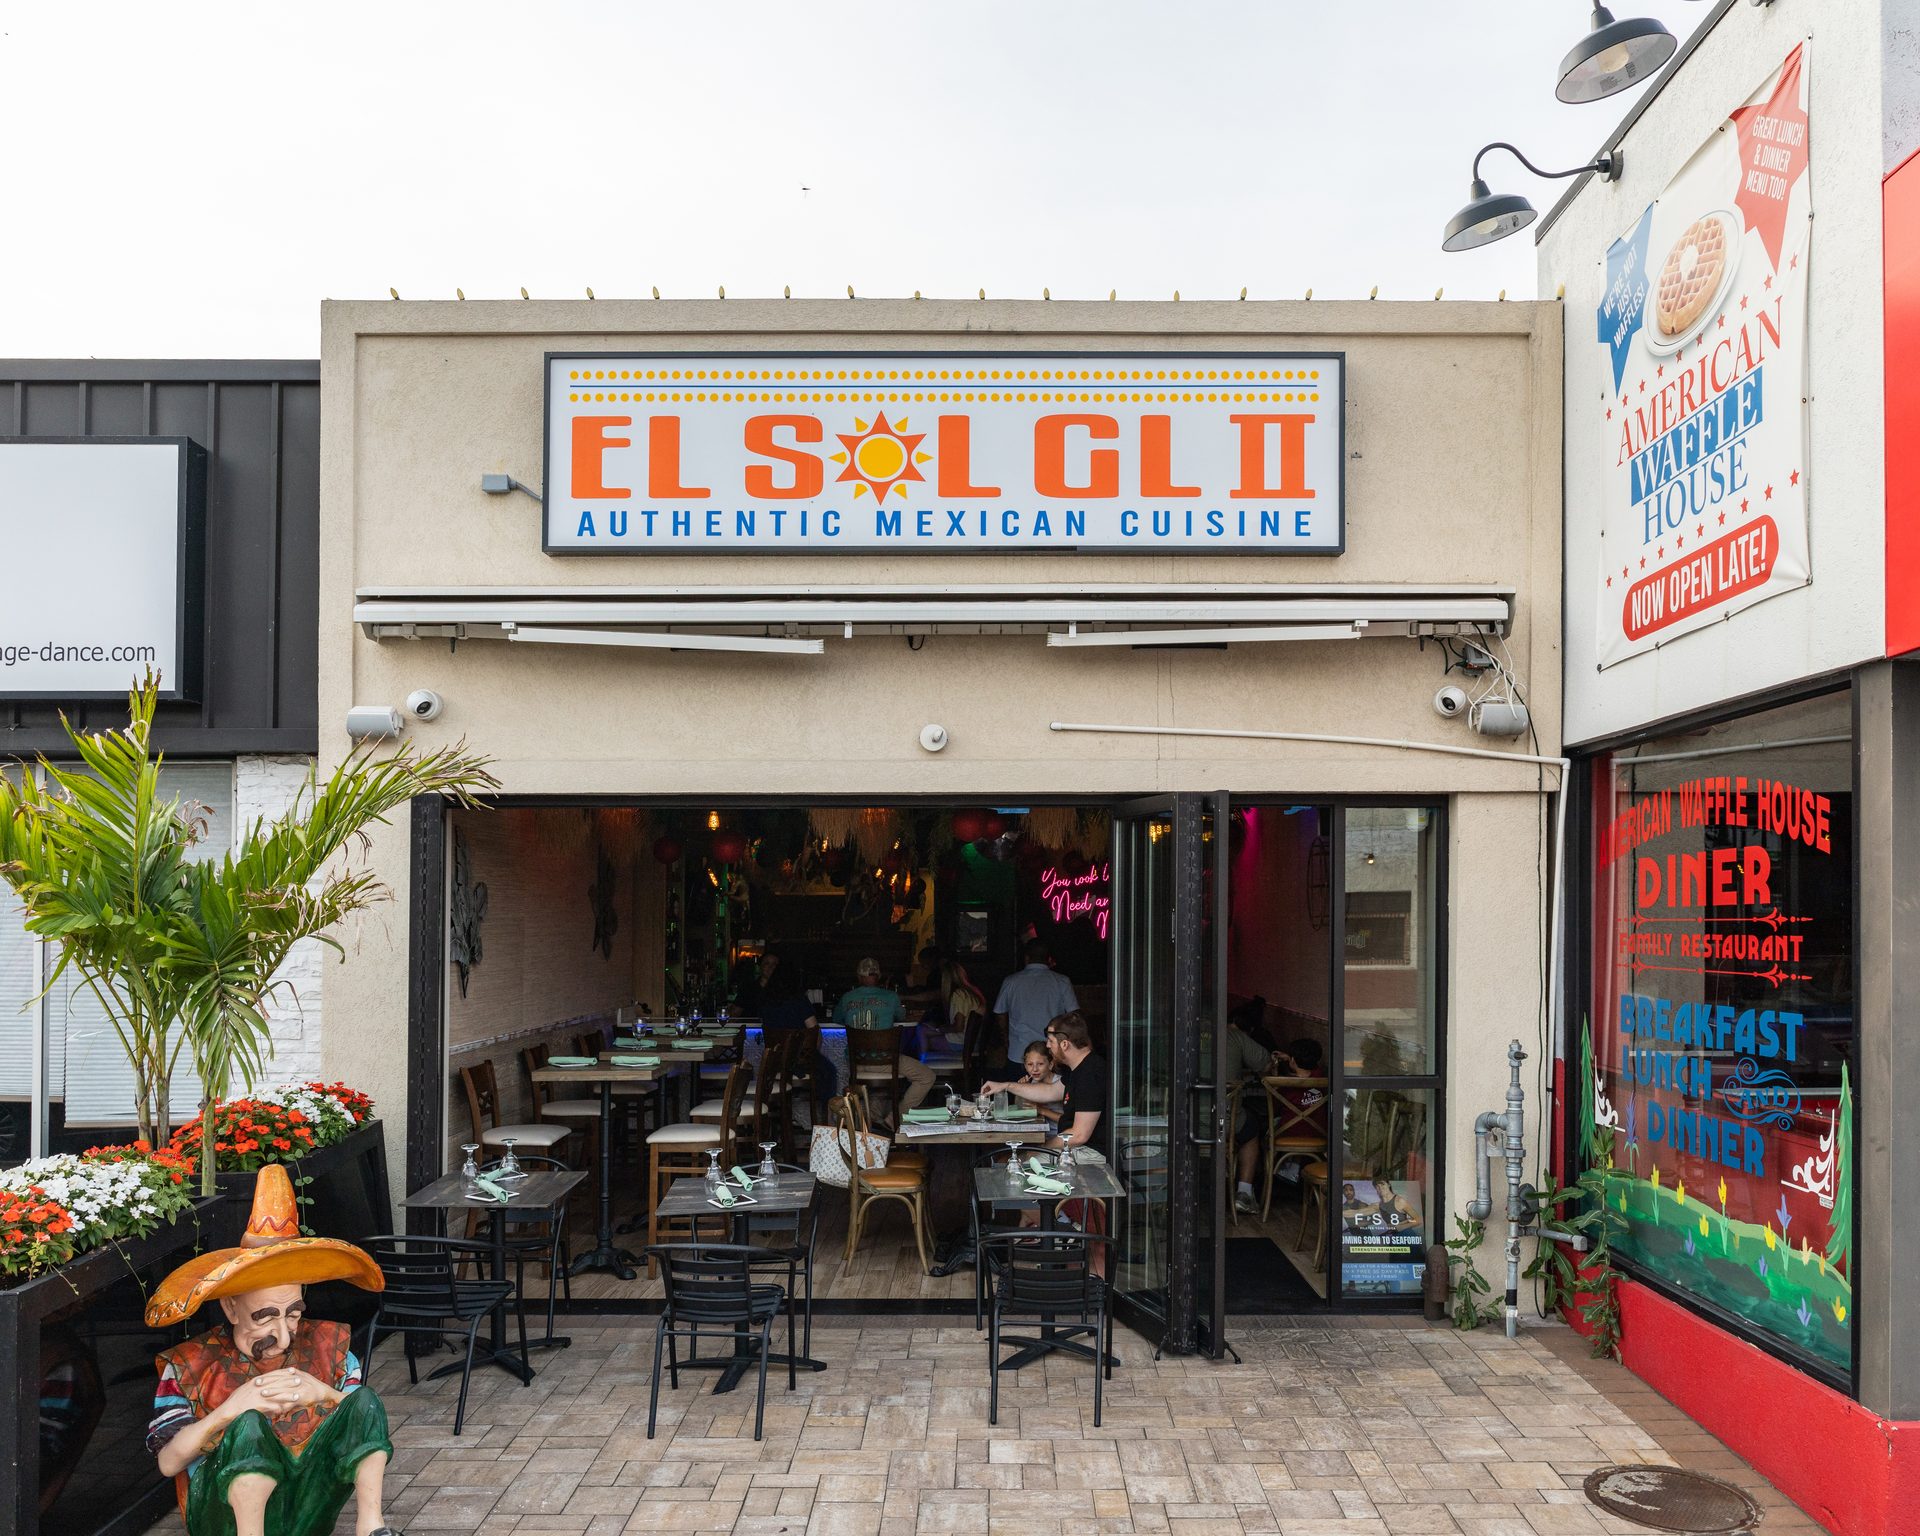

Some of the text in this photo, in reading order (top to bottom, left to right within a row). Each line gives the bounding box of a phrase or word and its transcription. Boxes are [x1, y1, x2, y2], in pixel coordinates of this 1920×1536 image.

[1752, 115, 1805, 147] GREAT LUNCH
[1753, 143, 1791, 173] & DINNER
[1745, 169, 1787, 201] MENU TOO!
[1603, 242, 1638, 320] WE'RE NOT
[1616, 280, 1633, 320] JUST
[1613, 282, 1645, 350] WAFFLES!
[1616, 295, 1784, 468] AMERICAN
[572, 415, 710, 498] EL
[1230, 414, 1315, 498] II
[1633, 373, 1761, 503] WAFFLE
[1643, 437, 1749, 546] HOUSE
[577, 510, 1312, 537] AUTHENTIC MEXICAN CUISINE
[1631, 524, 1768, 632] NOW OPEN LATE!
[1679, 776, 1748, 828] WAFFLE
[1757, 778, 1831, 855] HOUSE
[1041, 866, 1071, 899] You
[1051, 889, 1092, 922] Need
[1637, 846, 1771, 908] DINER
[1619, 932, 1803, 962] FAMILY RESTAURANT
[1620, 993, 1803, 1062] BREAKFAST
[1622, 1045, 1711, 1100] LUNCH
[1734, 1085, 1790, 1110] AND
[1648, 1100, 1764, 1177] DINNER
[1363, 1235, 1381, 1244] SOON
[1382, 1235, 1390, 1244] TO
[1391, 1235, 1422, 1244] SEAFORD!
